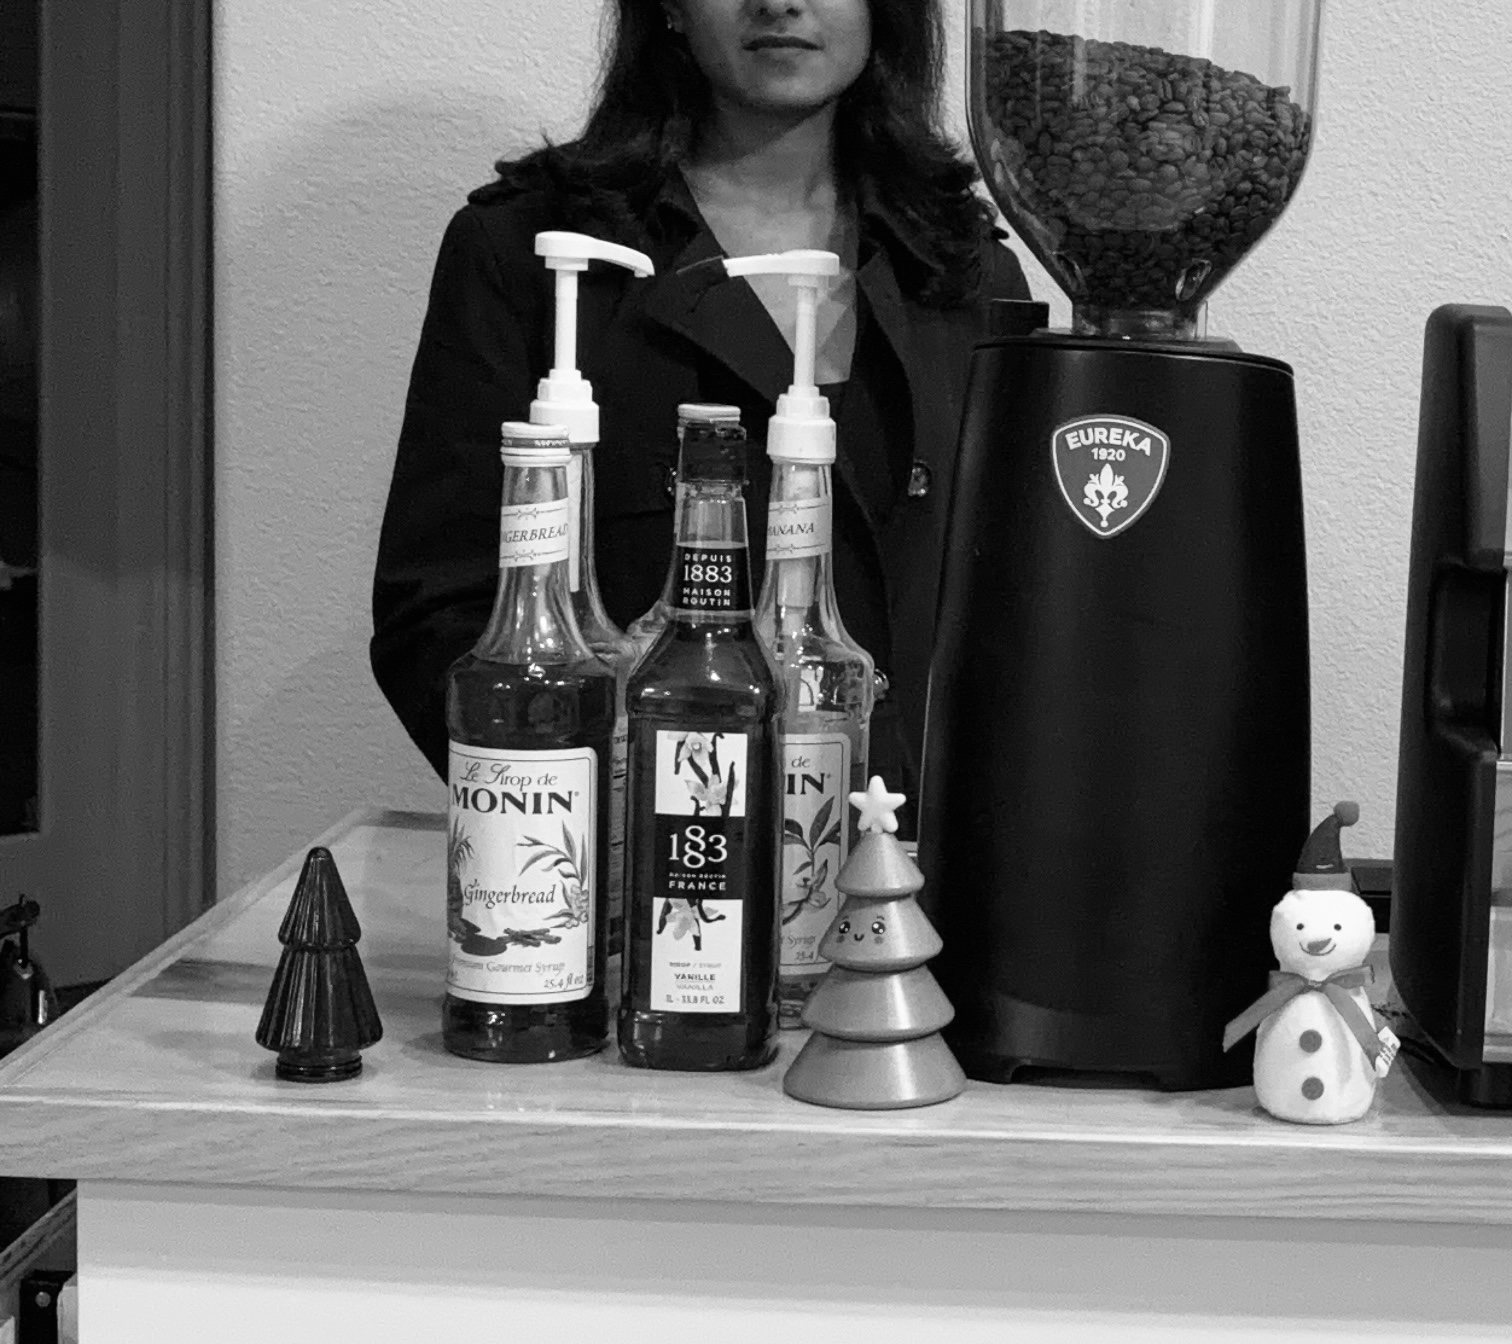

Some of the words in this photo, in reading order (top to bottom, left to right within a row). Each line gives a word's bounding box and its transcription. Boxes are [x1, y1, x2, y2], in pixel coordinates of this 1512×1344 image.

[1065, 427, 1151, 456] EUREKA
[1091, 447, 1126, 461] 1920
[684, 552, 732, 563] DEPUIS
[683, 564, 732, 584] 1883
[682, 596, 731, 607] ROUTIN
[791, 756, 811, 768] de
[460, 761, 481, 783] Le
[484, 763, 532, 792] Sirop
[537, 773, 558, 786] de
[452, 782, 573, 815] MONIN
[669, 824, 728, 869] 1883
[668, 880, 727, 891] FRANCE
[464, 879, 556, 910] Gingerbread
[674, 973, 717, 981] VANILLE
